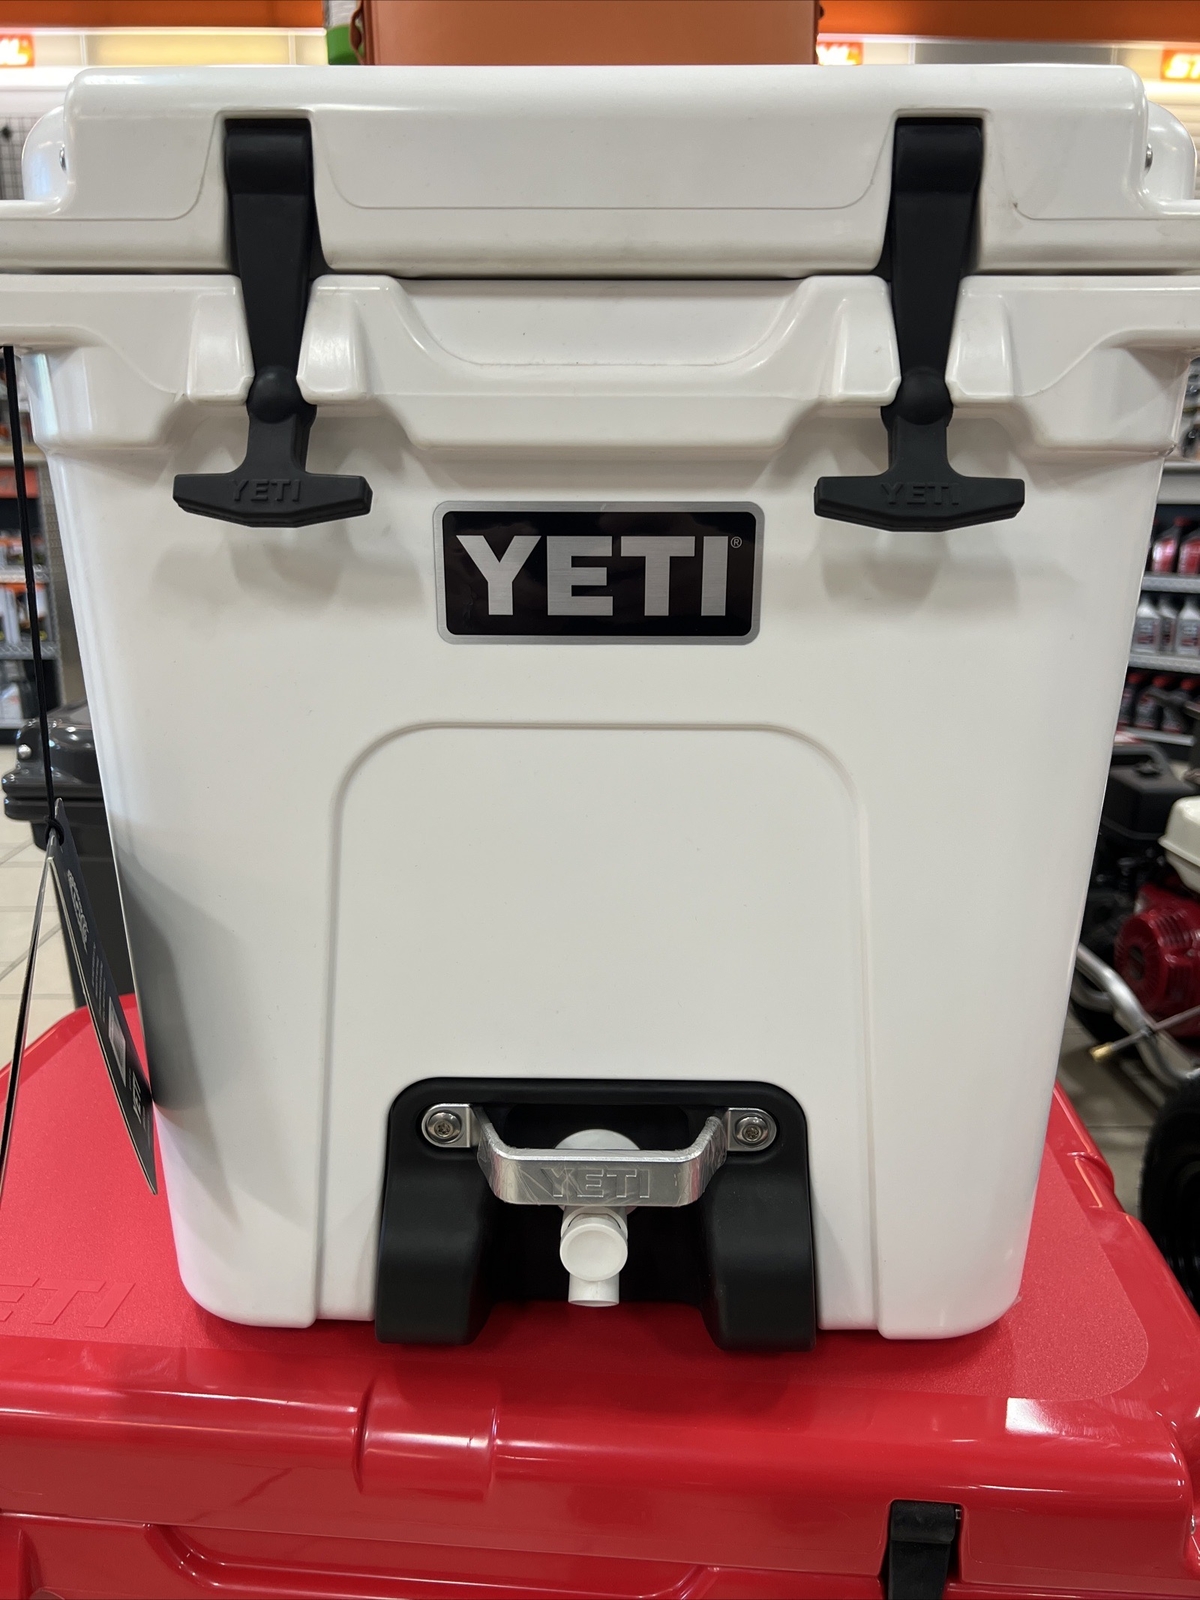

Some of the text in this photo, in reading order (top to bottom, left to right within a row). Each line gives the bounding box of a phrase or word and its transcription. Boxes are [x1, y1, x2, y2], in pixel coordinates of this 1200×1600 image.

[230, 479, 302, 502] YETI
[880, 482, 961, 506] YETI
[541, 1167, 651, 1199] YETI
